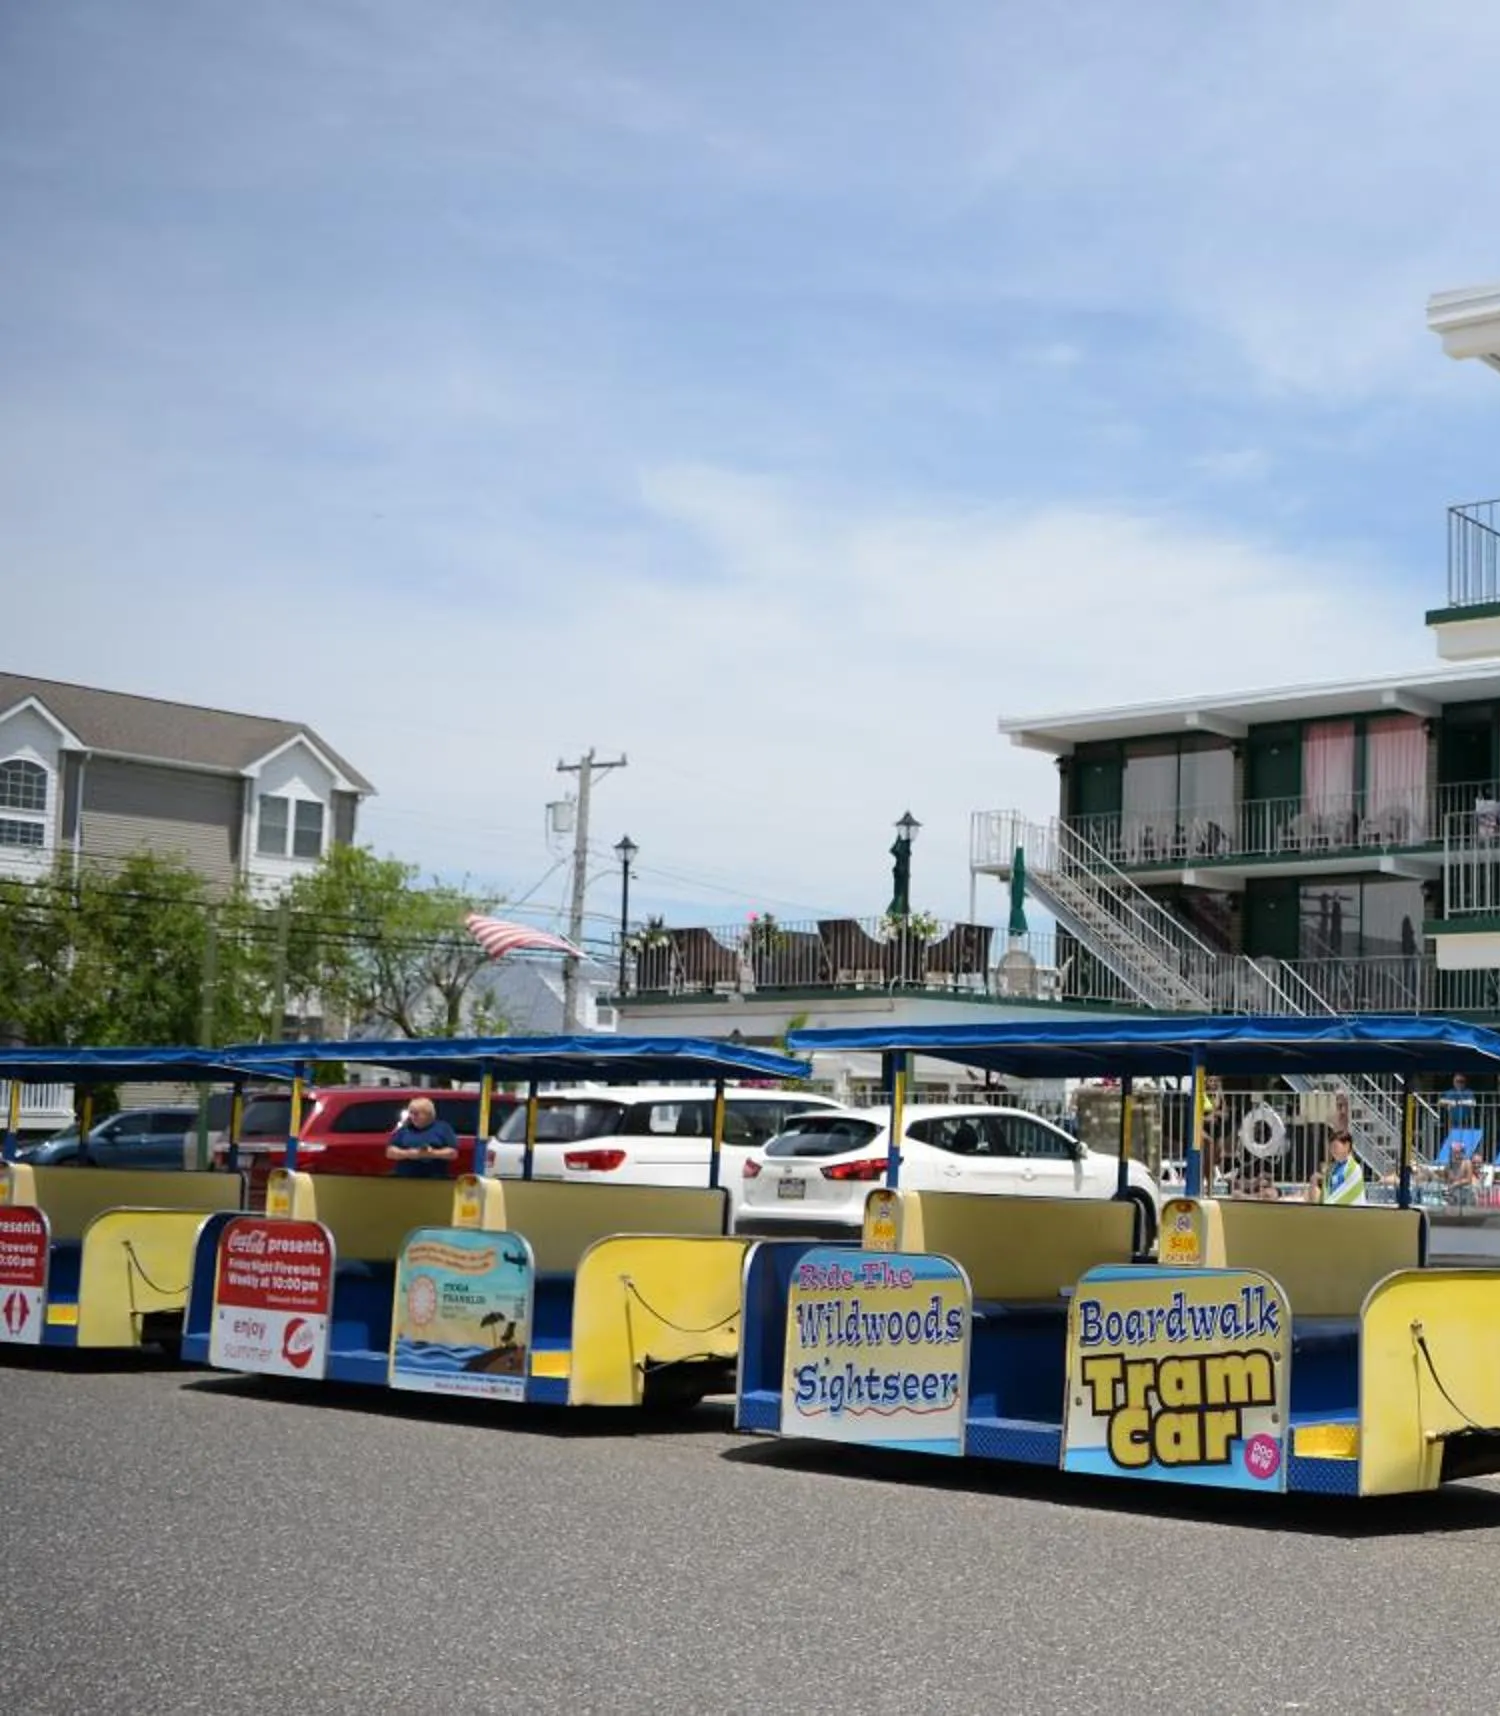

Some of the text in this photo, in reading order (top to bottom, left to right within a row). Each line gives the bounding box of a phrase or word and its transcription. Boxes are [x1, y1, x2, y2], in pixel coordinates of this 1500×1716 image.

[267, 1238, 325, 1255] presents
[798, 1260, 917, 1291] Ride The
[233, 1317, 267, 1341] enjoy
[796, 1296, 965, 1349] Wildwoods
[1079, 1286, 1281, 1347] Boardwalk
[793, 1357, 961, 1415] Sightseer
[1081, 1349, 1277, 1417] Tram
